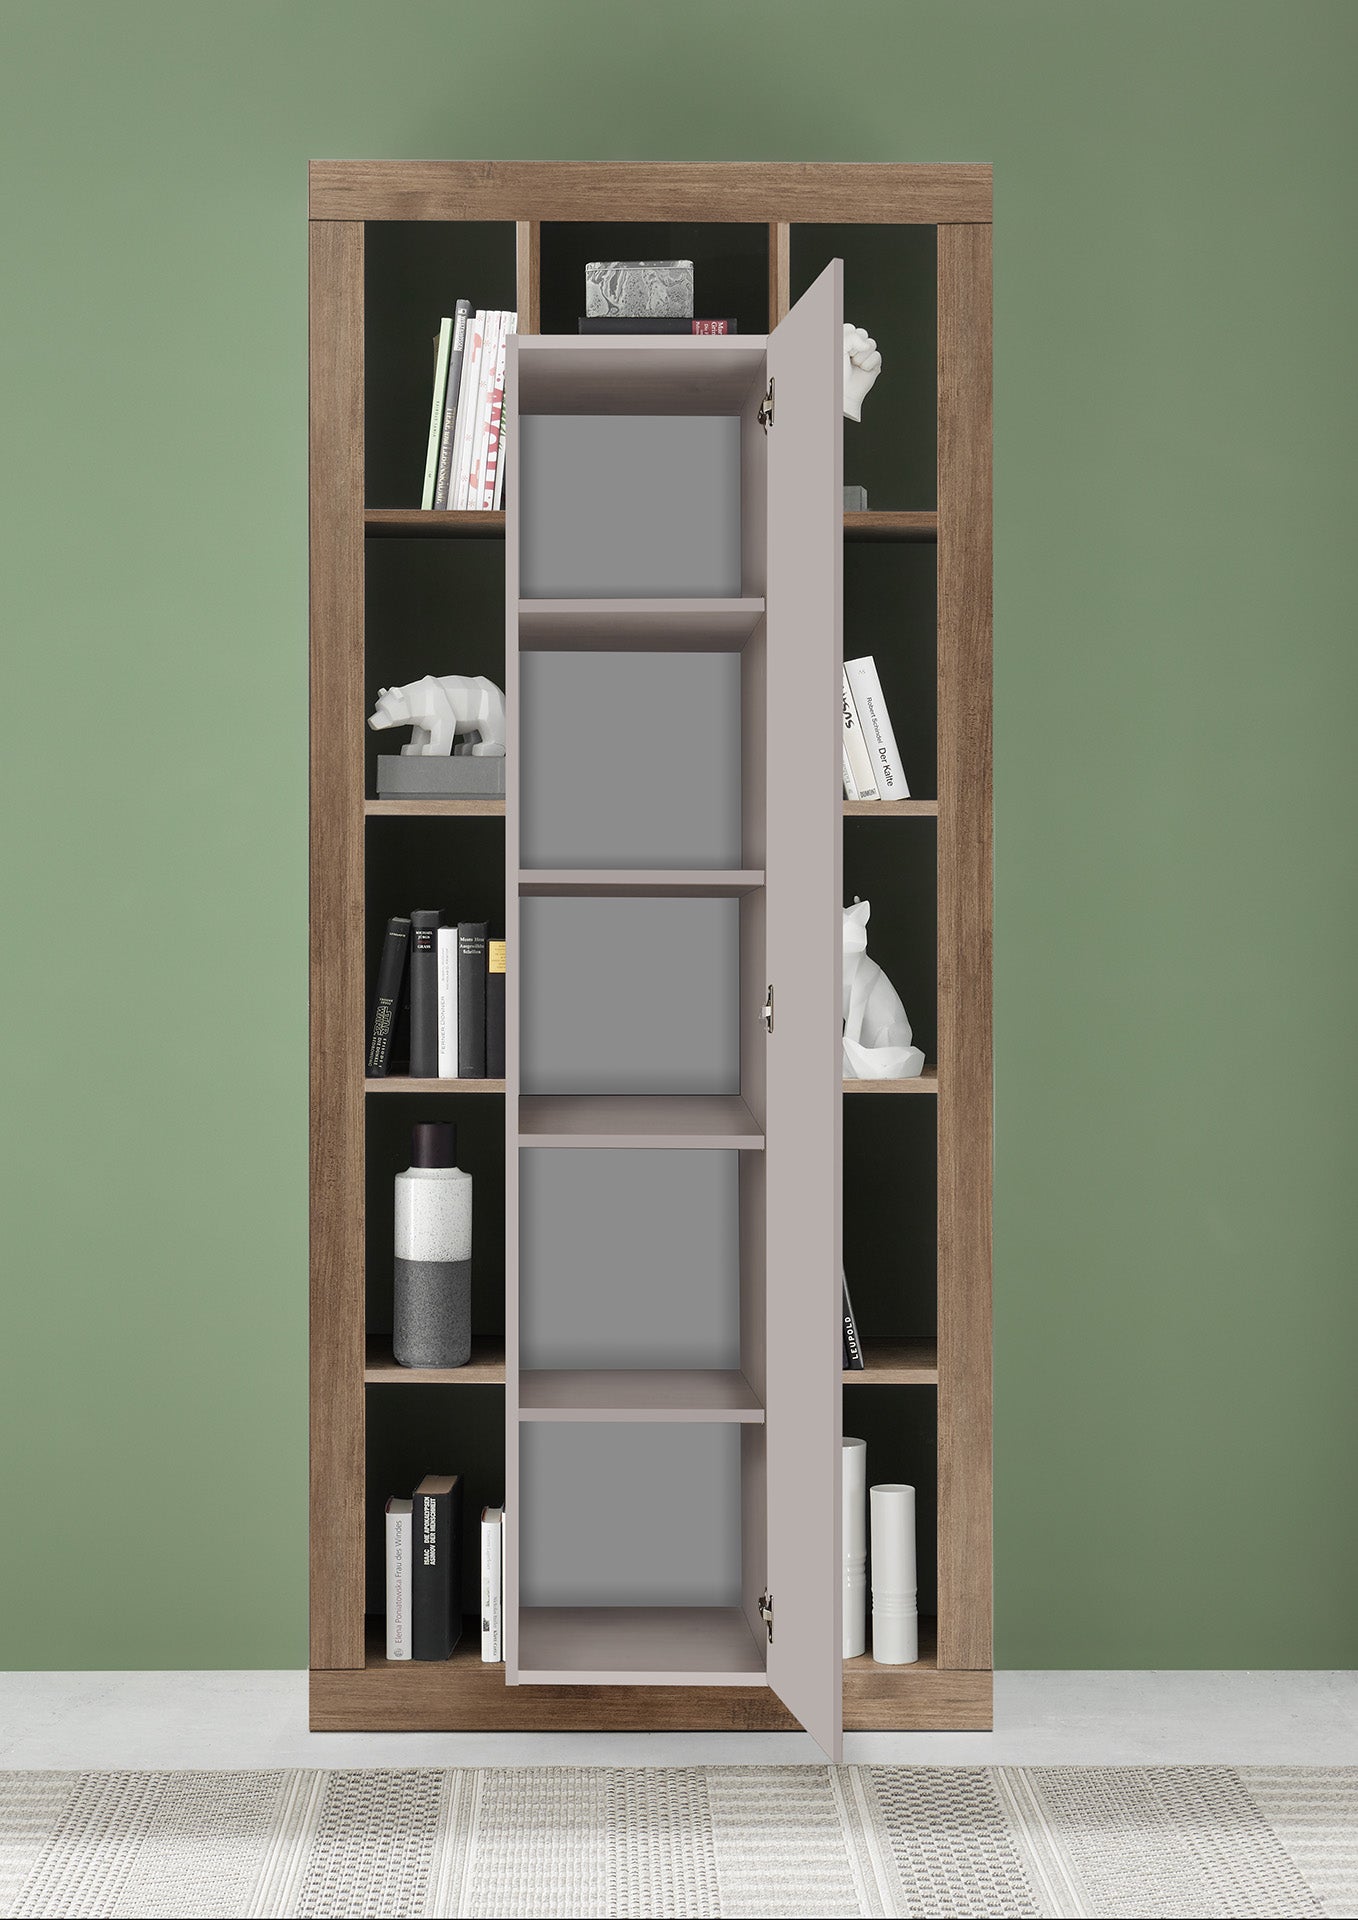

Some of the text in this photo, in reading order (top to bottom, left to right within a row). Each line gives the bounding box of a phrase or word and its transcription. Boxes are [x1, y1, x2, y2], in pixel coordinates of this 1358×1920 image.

[867, 697, 894, 787] Robert Schindel Der Kalte
[844, 1316, 859, 1360] LEUPOLD
